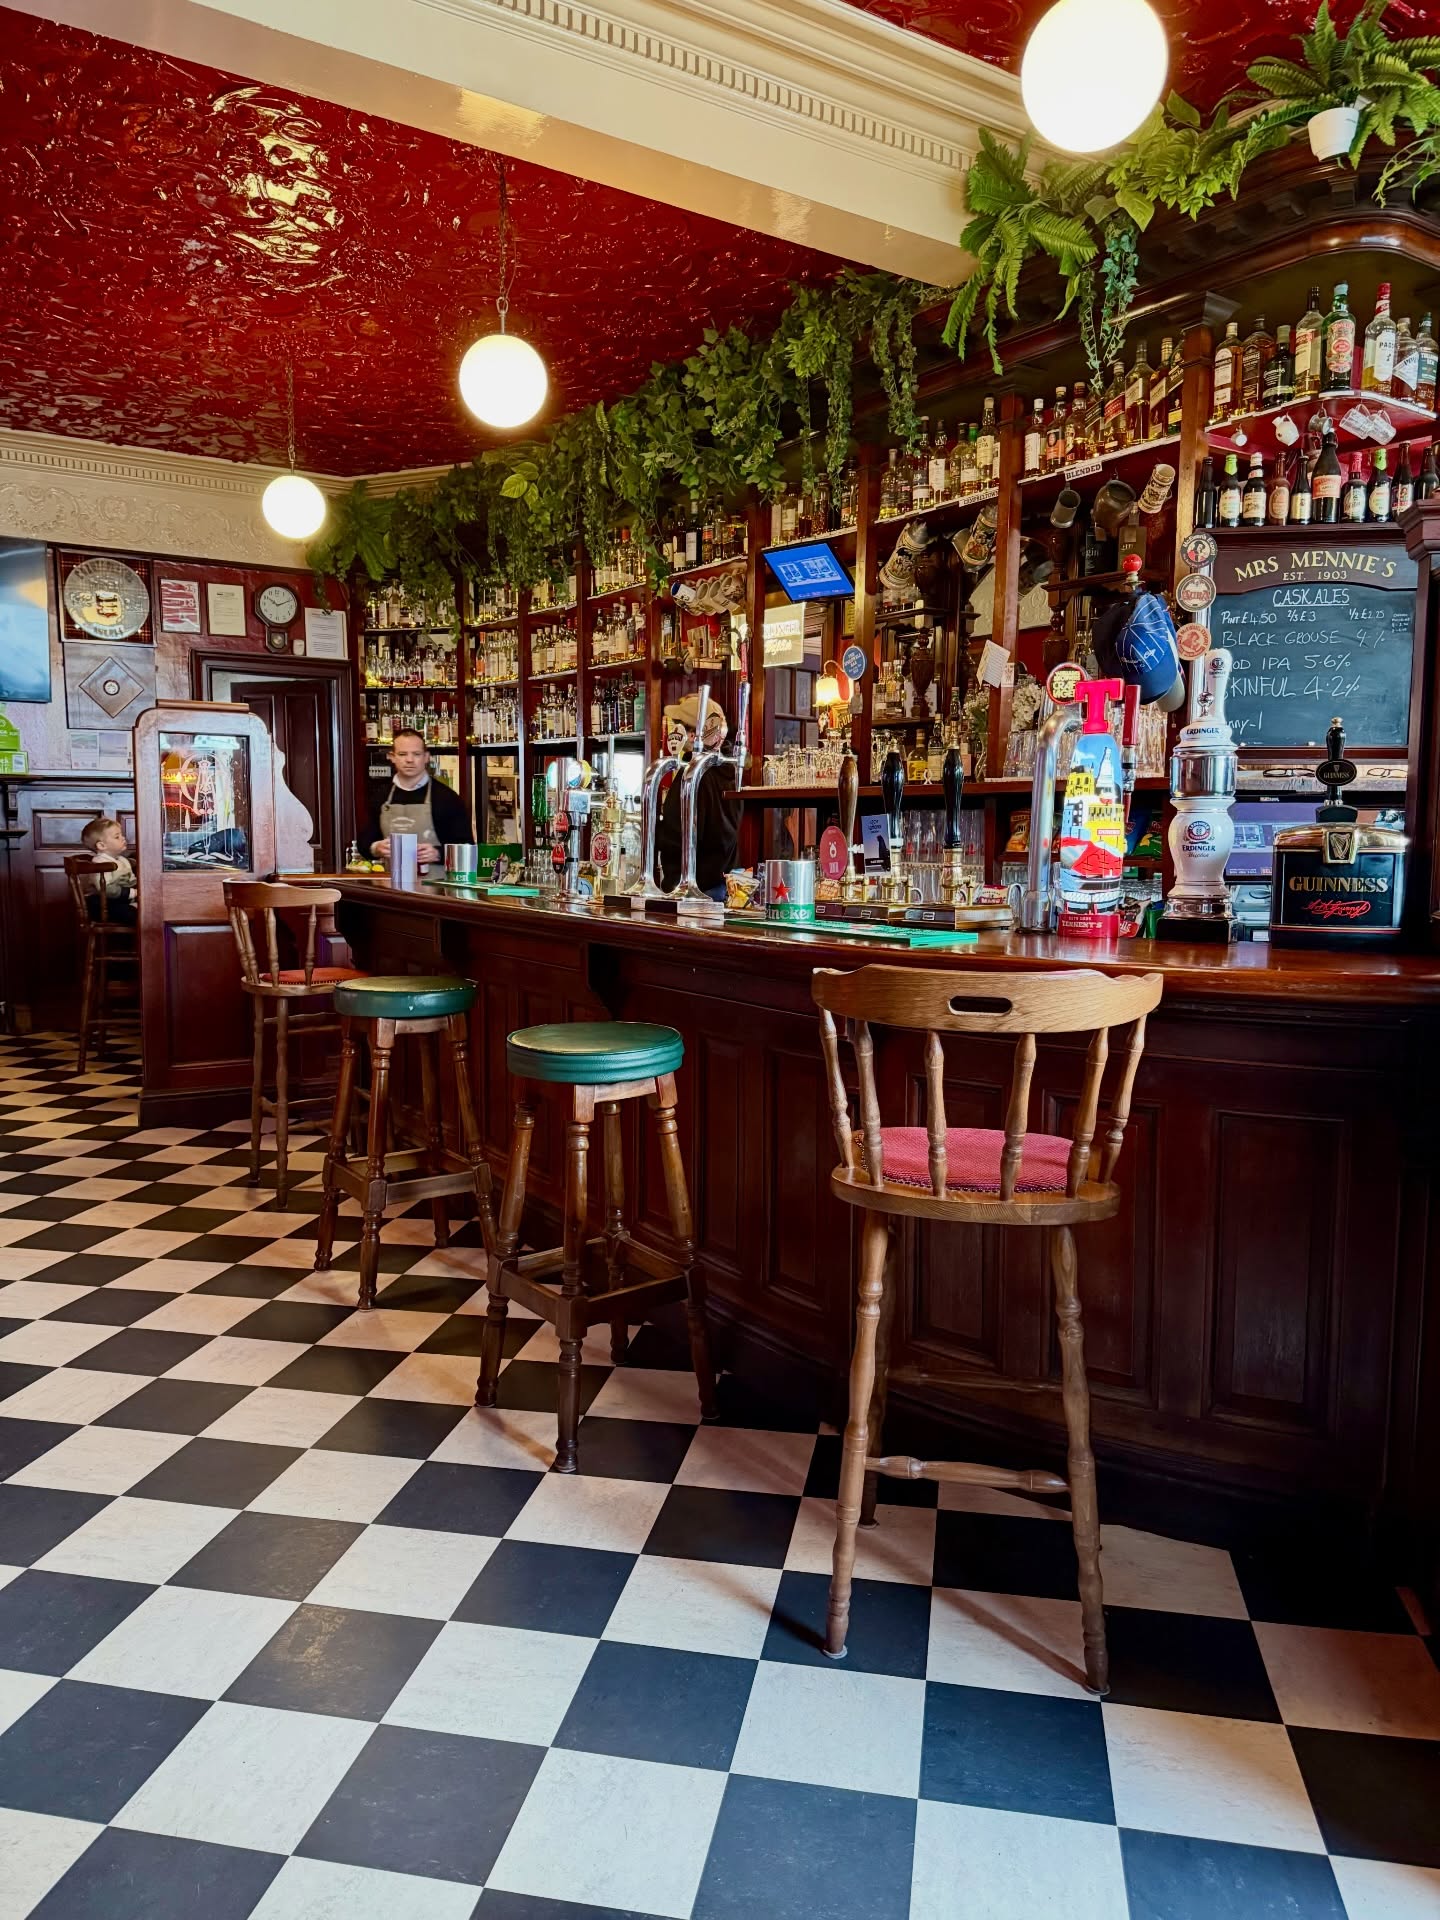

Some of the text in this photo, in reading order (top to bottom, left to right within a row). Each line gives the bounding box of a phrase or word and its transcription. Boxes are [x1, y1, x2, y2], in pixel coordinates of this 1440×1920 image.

[1066, 464, 1101, 480] BLENDED
[1235, 556, 1279, 582] MRS
[1291, 550, 1397, 578] MENNIE'S
[1283, 571, 1347, 581] EST. 1903
[1272, 588, 1350, 606] CASK ALES
[1287, 609, 1299, 623] 2/3
[1349, 608, 1360, 620] 1/2
[1222, 631, 1280, 648] BLACK
[1285, 630, 1344, 647] GROUSE
[1232, 659, 1251, 670] OD
[1262, 657, 1291, 671] IPA
[1224, 675, 1297, 699] KINFUL
[1075, 678, 1123, 734] T
[1186, 727, 1219, 735] ERDINGER
[1182, 844, 1216, 852] ERDINGER
[1289, 876, 1389, 893] GUINNESS
